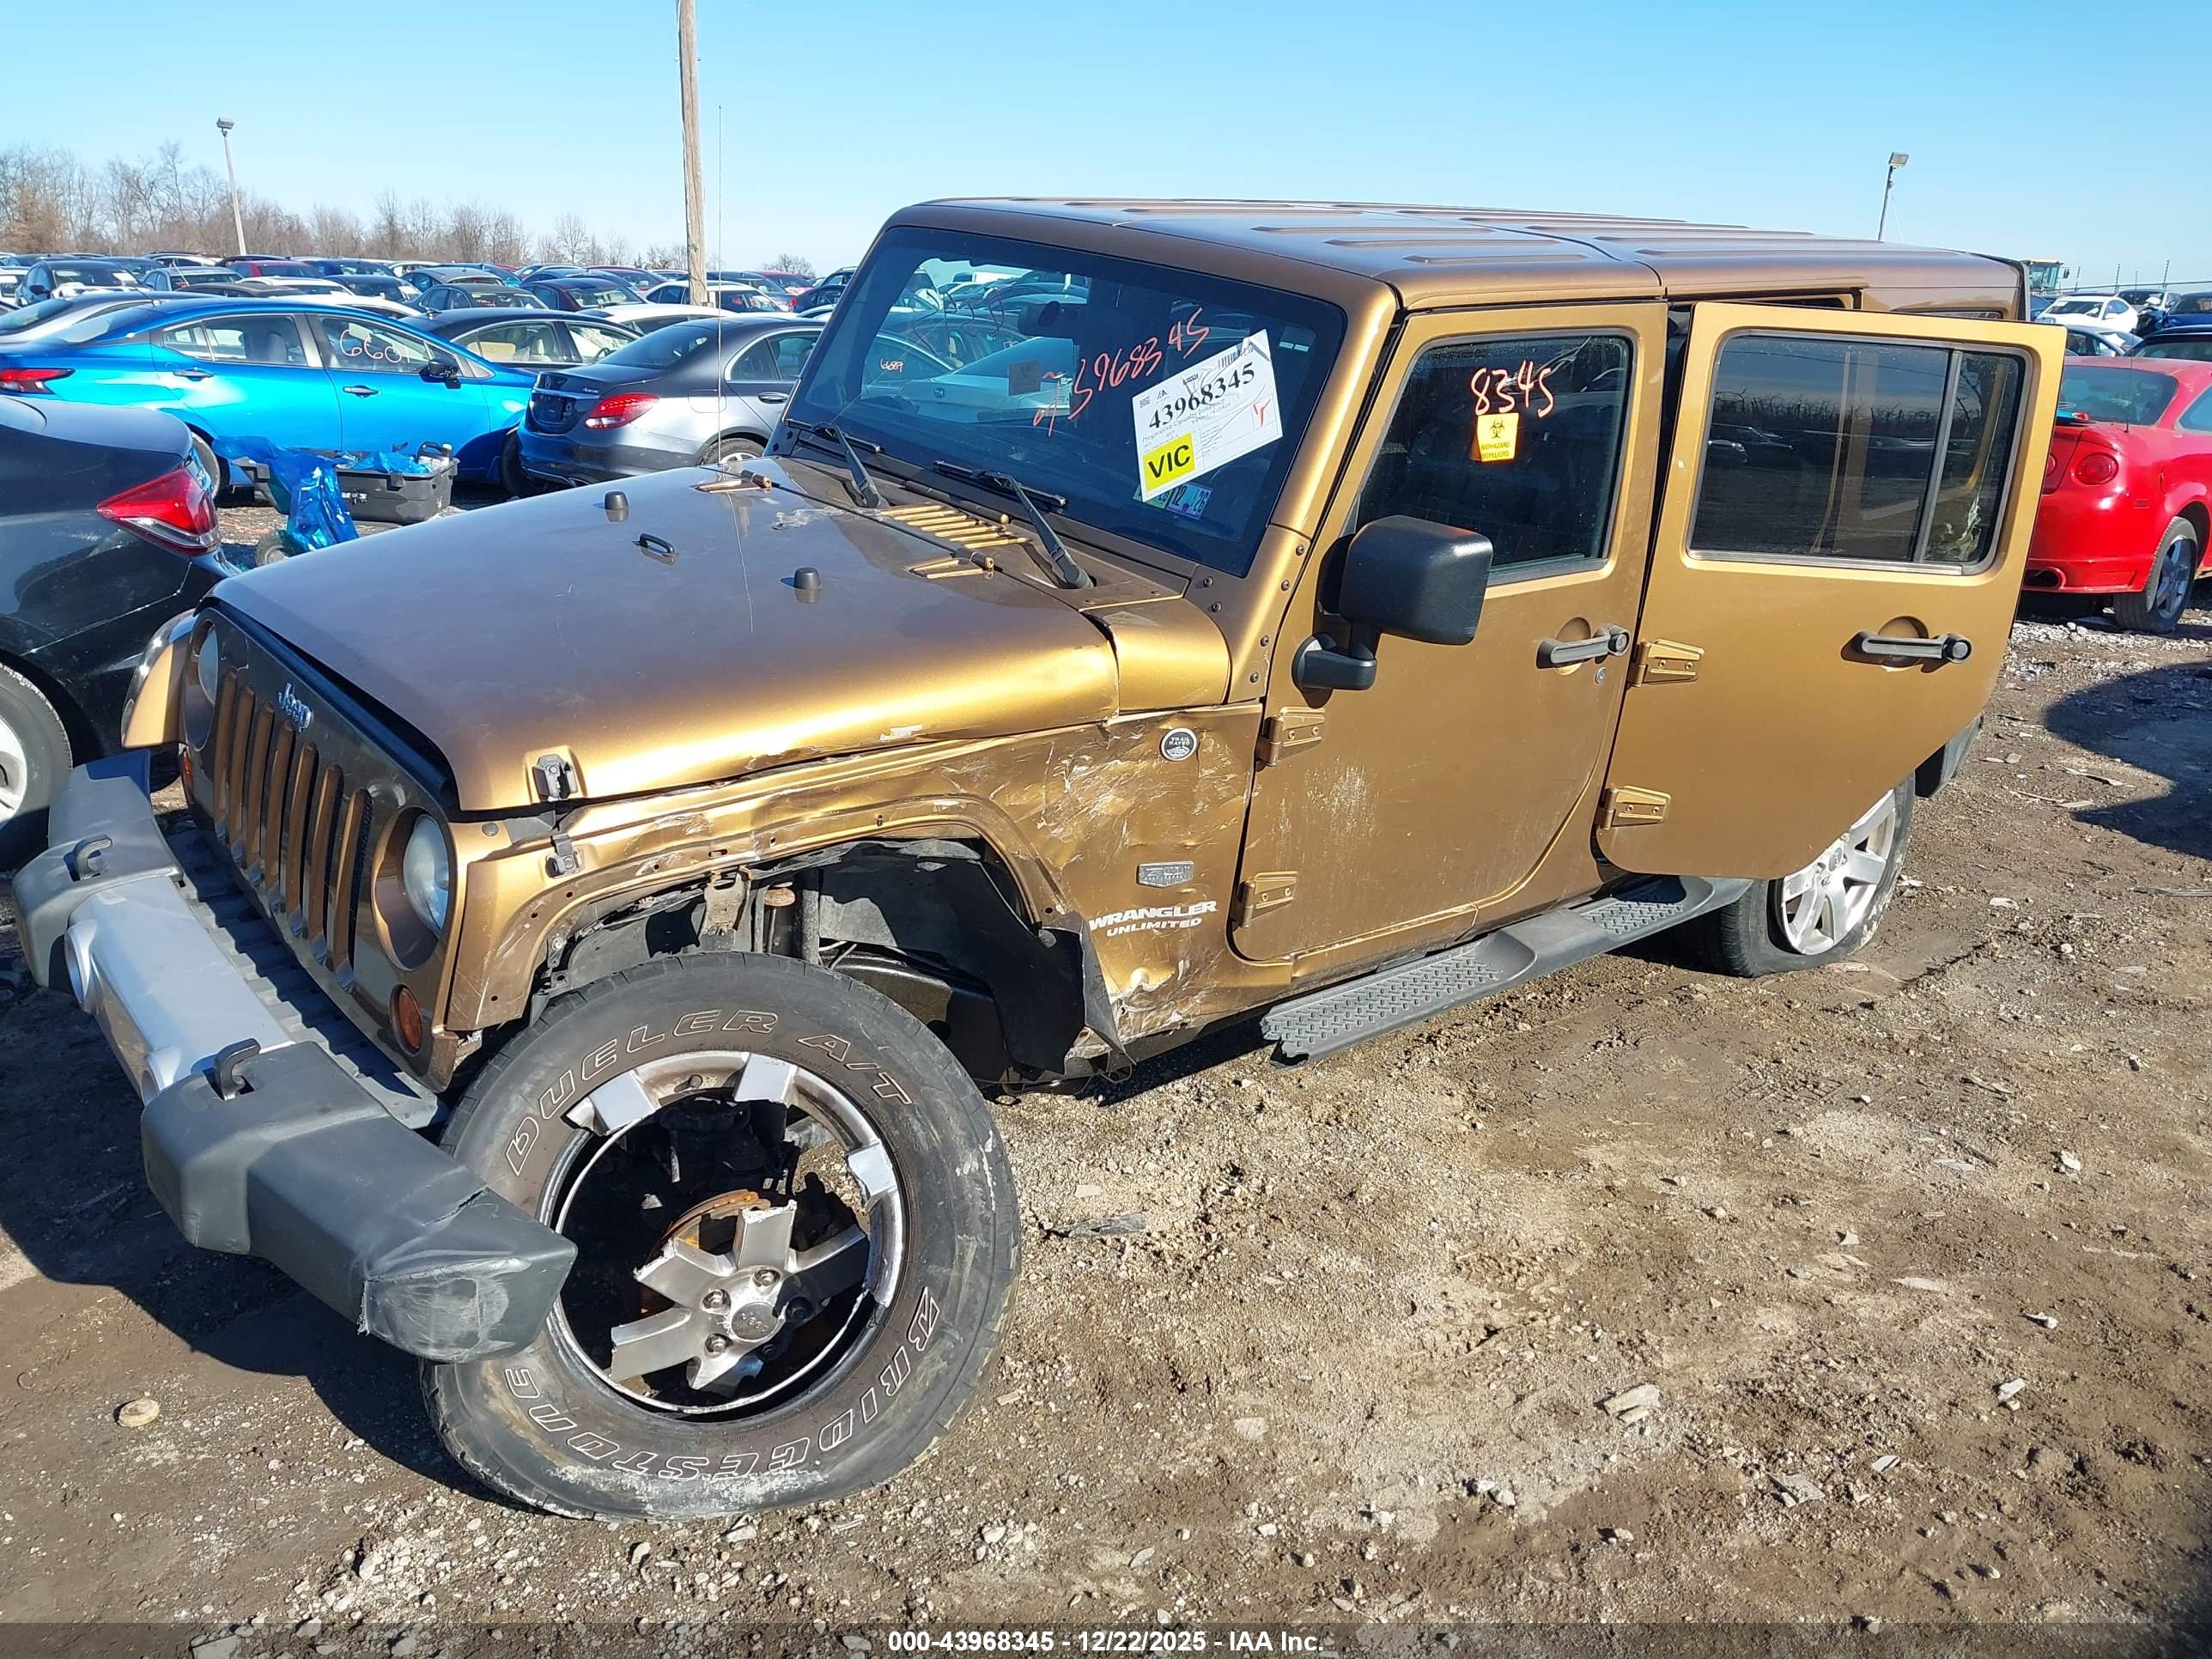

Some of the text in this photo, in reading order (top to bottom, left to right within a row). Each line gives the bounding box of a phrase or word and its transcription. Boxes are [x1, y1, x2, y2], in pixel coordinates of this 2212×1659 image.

[1149, 362, 1255, 428] 43968345
[1471, 359, 1553, 418] 8345
[1147, 444, 1191, 479] VIC
[1089, 900, 1217, 931] WRANGLER
[1106, 918, 1202, 937] UNLIMITED
[505, 1008, 913, 1176] DUELER A/T
[504, 1286, 940, 1481] BRIDGESTONE
